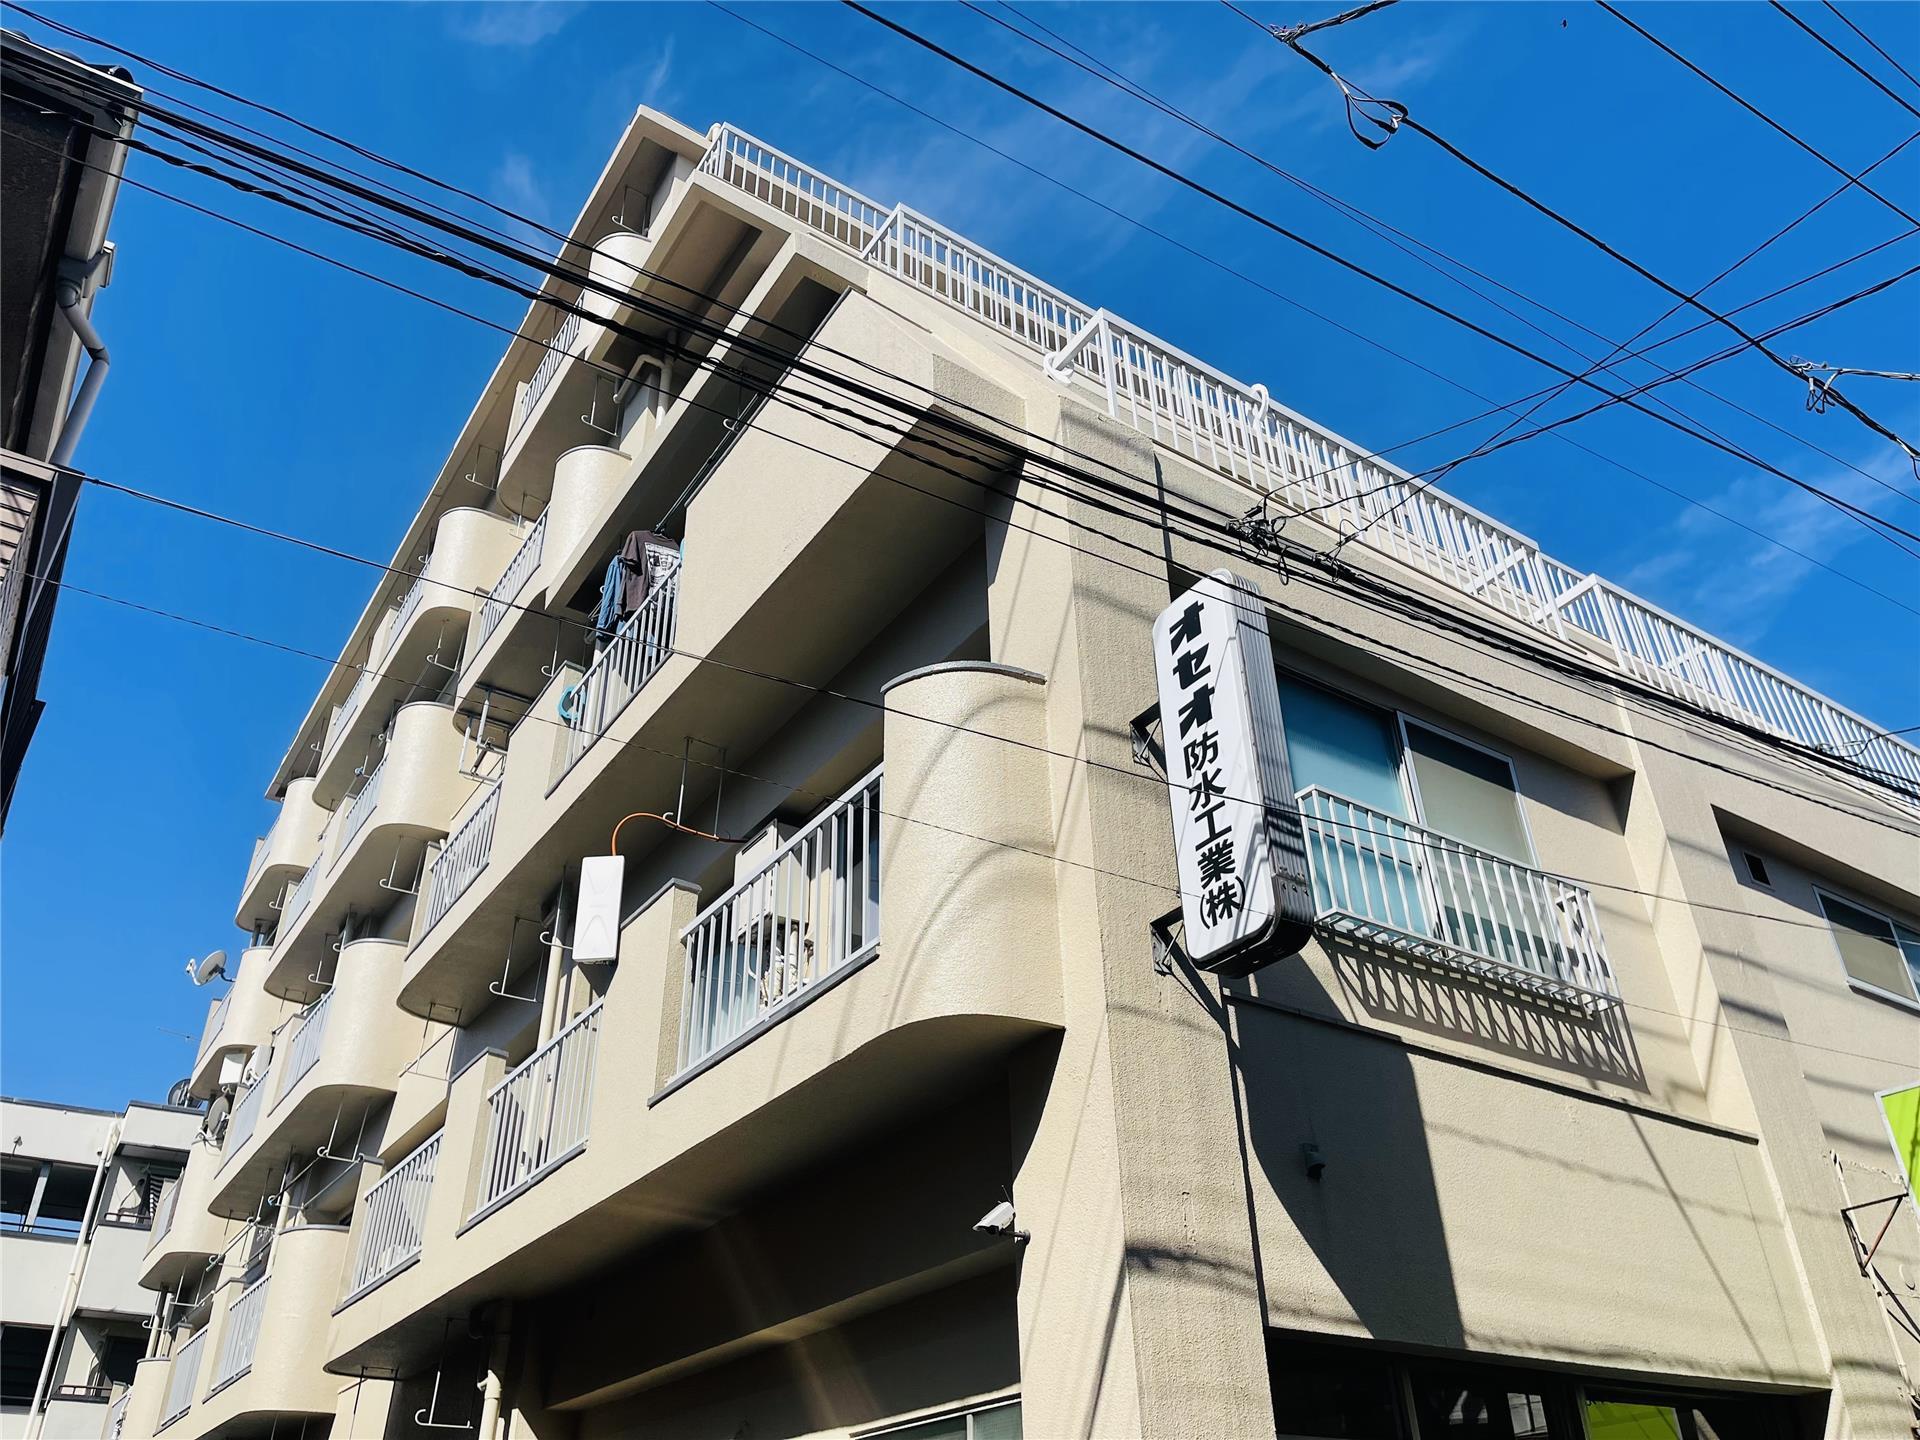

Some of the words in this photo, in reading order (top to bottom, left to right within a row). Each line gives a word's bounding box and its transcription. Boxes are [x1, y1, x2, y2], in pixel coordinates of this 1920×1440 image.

[1169, 600, 1246, 930] オセオ防水工業(株)
